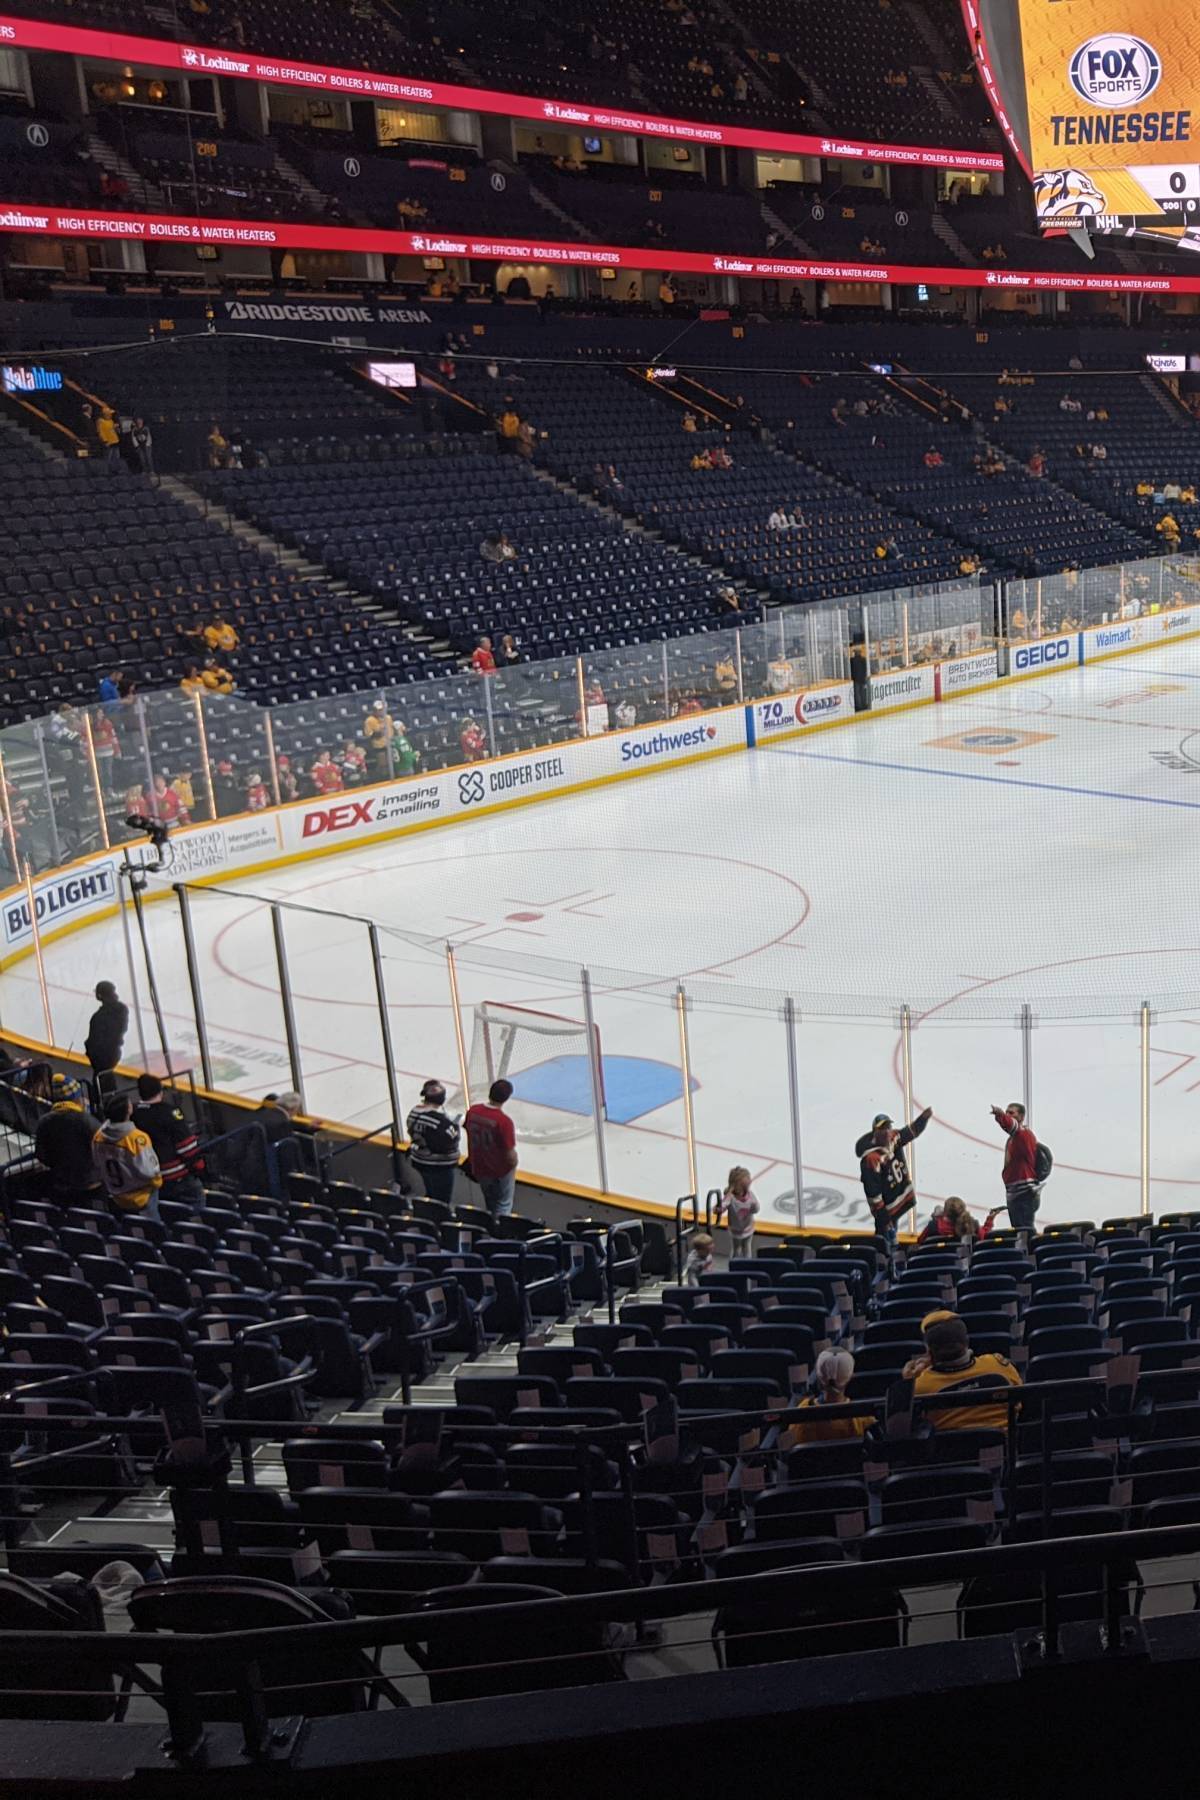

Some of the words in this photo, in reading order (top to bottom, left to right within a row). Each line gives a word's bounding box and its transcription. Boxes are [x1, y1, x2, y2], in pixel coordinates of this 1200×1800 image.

[1088, 48, 1139, 80] FOX
[200, 53, 249, 73] Lochinvar
[257, 65, 279, 77] HIGH
[281, 67, 327, 85] EFFICIENCY
[330, 75, 363, 89] BOILERS
[372, 81, 400, 95] WATER
[400, 85, 433, 99] HEATERS
[1090, 79, 1141, 93] SPORTS
[1051, 110, 1191, 146] TENNESSEE
[832, 144, 864, 156] Lochinvar
[867, 150, 884, 158] HIGH
[885, 151, 920, 161] EFFICIENCY
[922, 154, 948, 163] BOILERS
[955, 156, 977, 166] WATER
[977, 158, 1004, 167] HEATERS
[1169, 172, 1187, 193] 0
[1163, 201, 1180, 211] SOG
[1186, 200, 1197, 212] 0
[57, 218, 86, 230] HIGH
[87, 220, 145, 234] EFFICIENCY
[150, 224, 190, 237] BOILERS
[202, 227, 235, 240] WATER
[236, 228, 276, 242] HEATERS
[1096, 215, 1124, 229] NHL
[425, 238, 467, 253] Lochinvar
[472, 244, 491, 254] HIGH
[492, 245, 532, 257] EFFICIENCY
[533, 248, 561, 259] BOILERS
[568, 250, 592, 262] WATER
[592, 252, 620, 263] HEATERS
[723, 259, 754, 272] Lochinvar
[756, 264, 773, 273] HIGH
[773, 265, 808, 275] EFFICIENCY
[810, 267, 835, 276] BOILERS
[841, 268, 862, 278] WATER
[862, 269, 888, 279] HEATERS
[997, 274, 1030, 285] Lochinvar
[1034, 277, 1050, 286] HIGH
[1050, 278, 1085, 287] EFFICIENCY
[1086, 279, 1113, 288] BOILERS
[1120, 280, 1142, 289] WATER
[1143, 281, 1170, 289] HEATERS
[226, 302, 374, 323] BRIDGESTONE
[378, 310, 432, 324] ARENA
[1096, 627, 1132, 649] Walmart
[948, 655, 998, 675] BRENTWOOD
[1015, 639, 1070, 669] GEICO
[949, 672, 967, 685] AUTO
[967, 667, 998, 682] BROKERS
[763, 714, 795, 729] MILLION
[621, 725, 707, 762] Southwest
[489, 767, 533, 793] COOPER
[535, 756, 565, 781] STEEL
[382, 785, 439, 807] imaging
[302, 799, 375, 839] DEX
[376, 810, 388, 821] &
[390, 797, 441, 818] mailing
[228, 829, 260, 846] Mergers
[167, 853, 225, 878] ADVISORS
[7, 901, 46, 935] BUD
[48, 871, 110, 913] LIGHT
